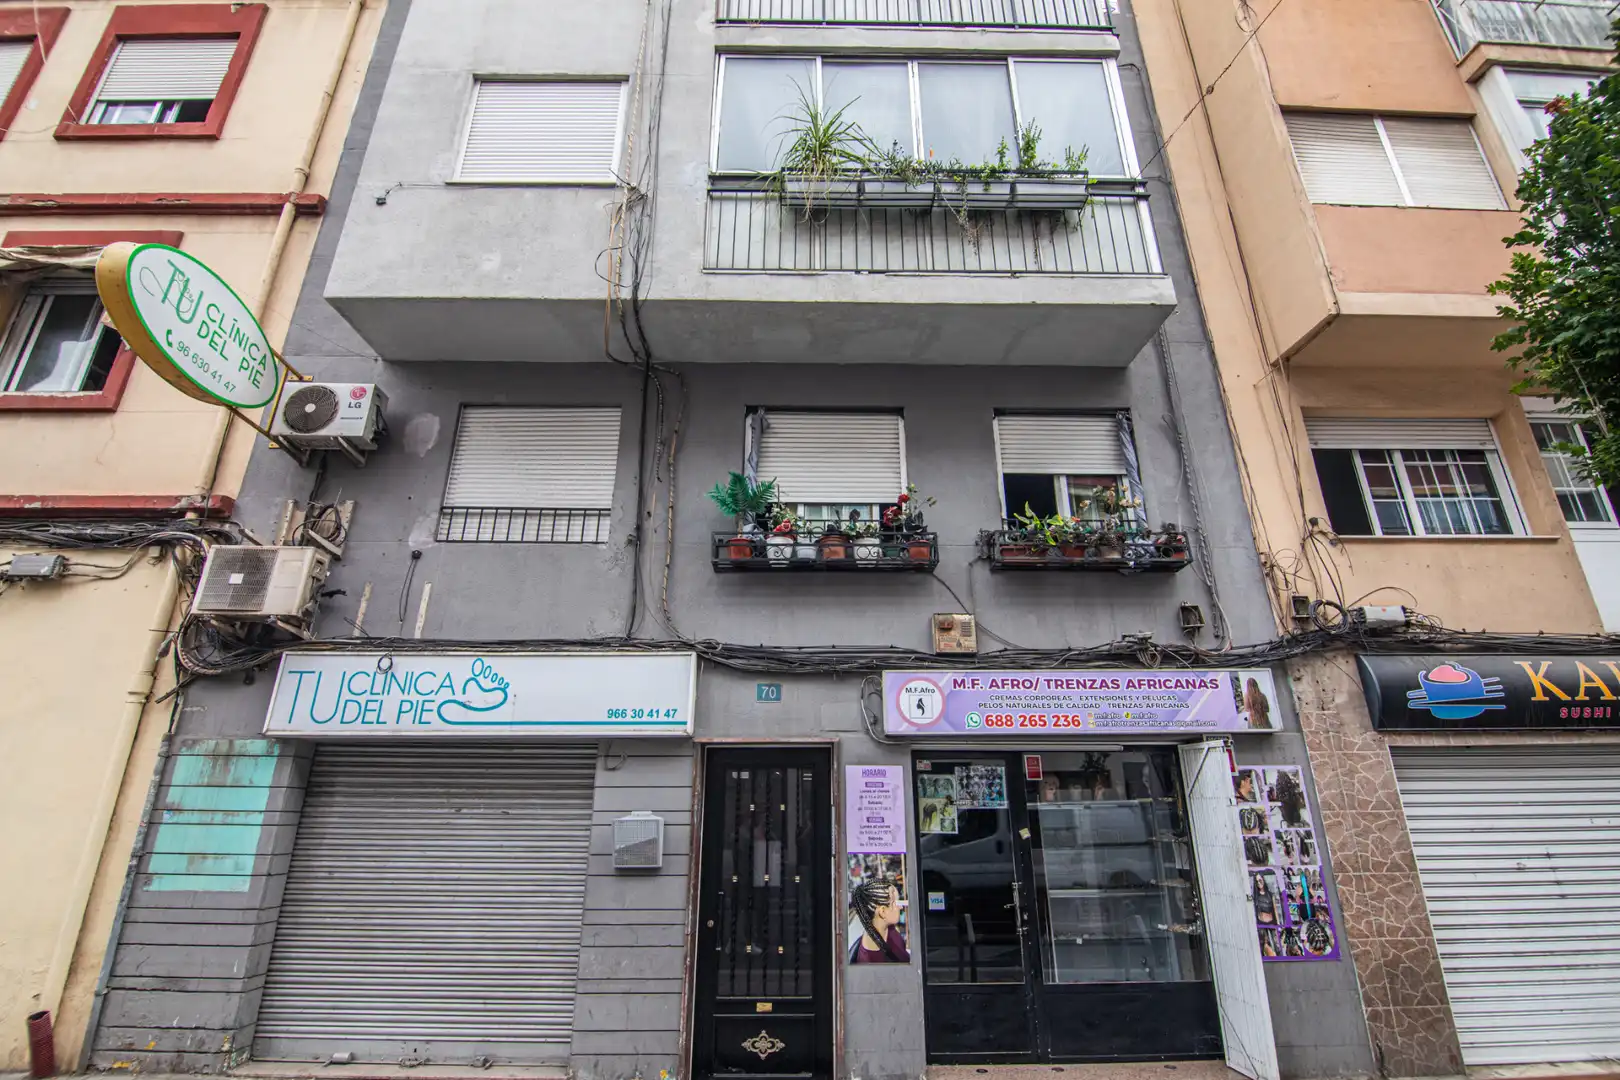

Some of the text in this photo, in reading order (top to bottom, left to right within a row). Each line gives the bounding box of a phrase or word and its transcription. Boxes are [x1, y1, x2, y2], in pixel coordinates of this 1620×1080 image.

[161, 259, 267, 371] TU CLÍNICA
[197, 320, 264, 390] DEL PIE
[176, 341, 236, 393] 96 630 41 47
[348, 401, 362, 409] LG
[905, 686, 936, 694] M.F.Afro
[952, 677, 1219, 691] M.F. AFRO/ TRENZAS AFRICANAS
[288, 670, 346, 724] TU
[761, 686, 777, 699] 70
[340, 699, 435, 724] DEL PIE
[607, 708, 678, 719] 966 30 41 47
[1560, 706, 1611, 719] SUSHI
[985, 714, 1081, 728] 688 265 236
[862, 768, 887, 777] HORARIO
